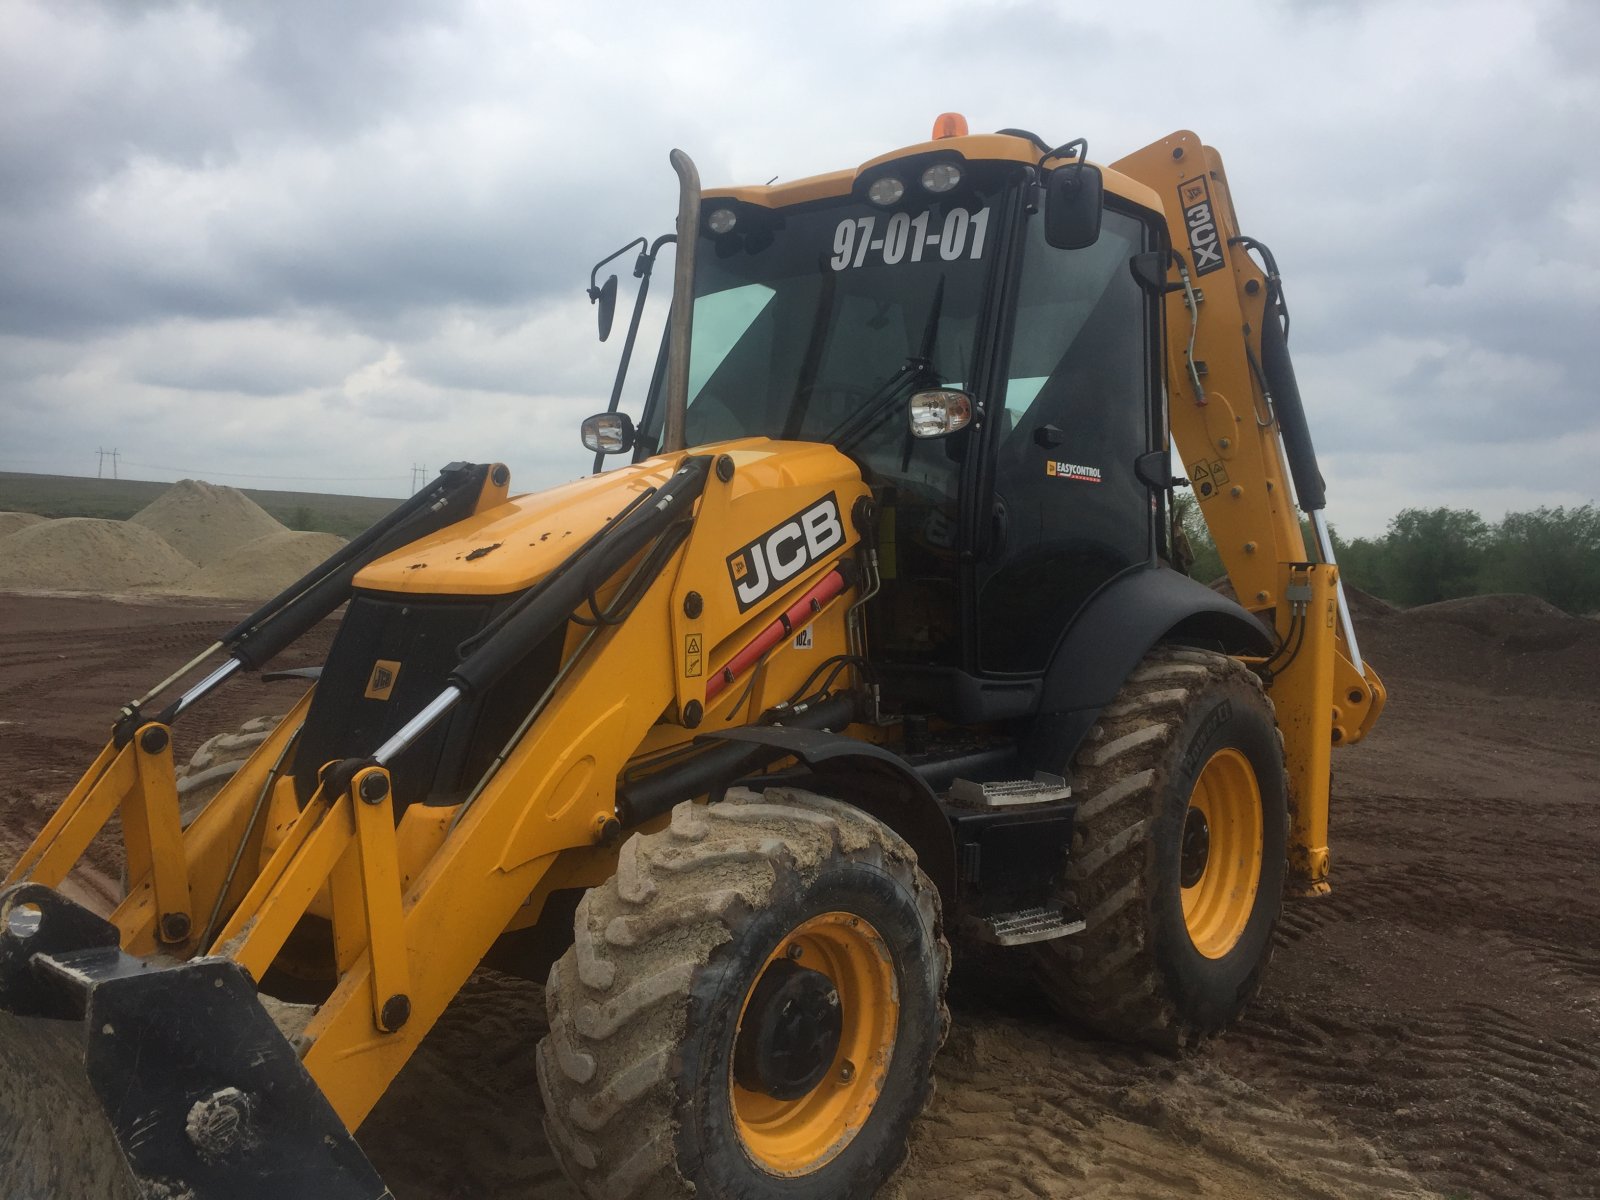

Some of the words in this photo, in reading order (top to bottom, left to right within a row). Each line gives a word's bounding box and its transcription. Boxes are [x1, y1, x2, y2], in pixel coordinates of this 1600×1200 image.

[831, 207, 990, 271] 97-01-01
[1187, 203, 1222, 268] 3CX
[1057, 462, 1101, 478] EASYCONTROL
[737, 500, 842, 604] JCB
[374, 666, 392, 690] JCB
